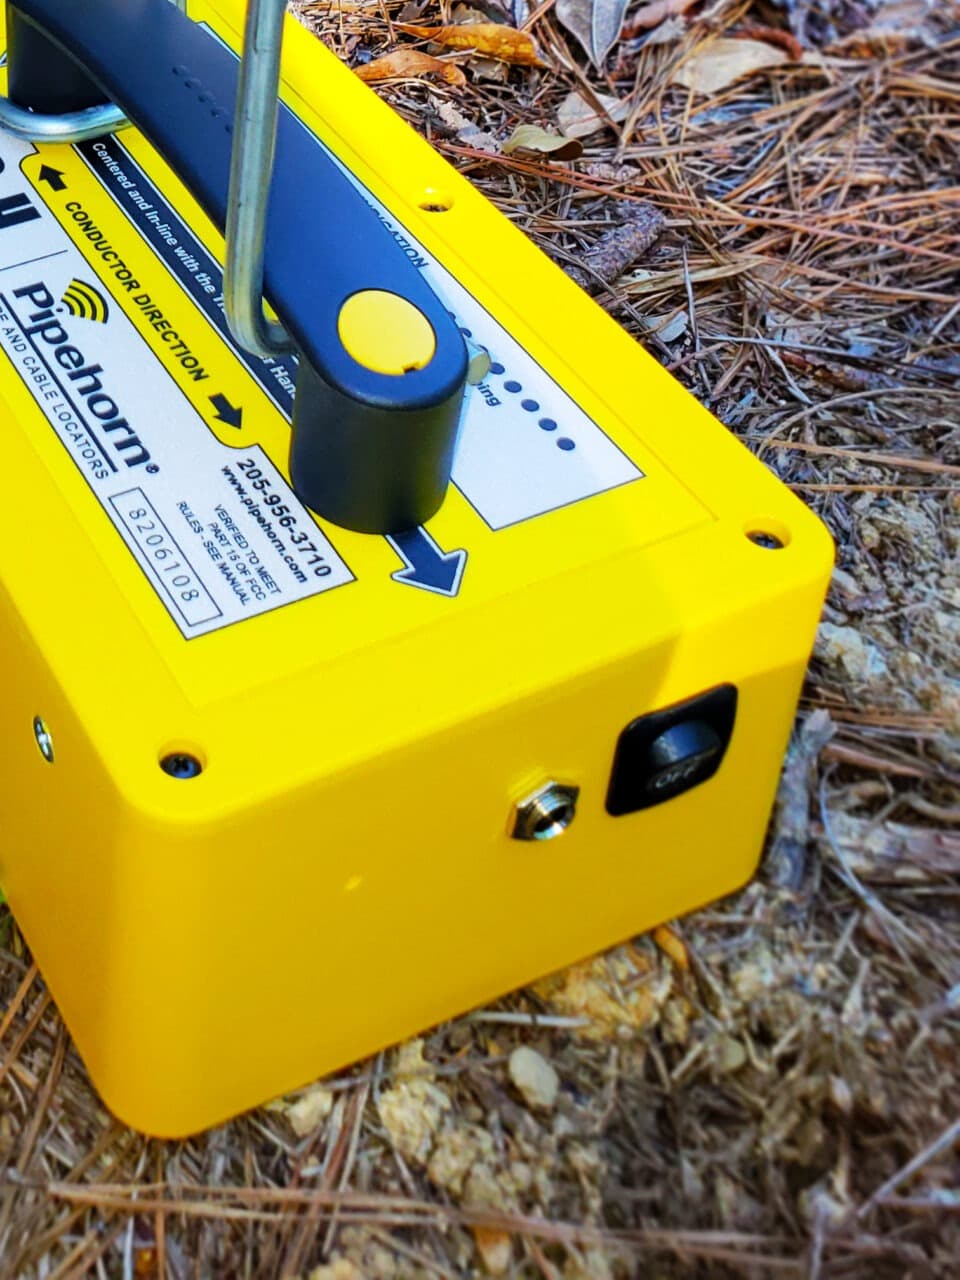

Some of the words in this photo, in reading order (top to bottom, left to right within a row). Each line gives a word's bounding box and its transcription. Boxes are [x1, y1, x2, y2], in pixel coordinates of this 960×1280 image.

[92, 142, 130, 189] Centered
[128, 188, 151, 211] and
[145, 210, 177, 247] In-line
[174, 245, 200, 273] with
[194, 272, 216, 294] the
[65, 201, 140, 292] CONDUCTOR
[133, 293, 209, 381] DIRECTION
[2, 326, 27, 353] AND
[22, 356, 59, 400] CABLE
[53, 403, 109, 480] LOCATORS
[128, 509, 200, 602] 8206108
[176, 501, 204, 534] RULES
[203, 540, 222, 561] SEE
[216, 562, 251, 606] MANUAL
[208, 522, 232, 547] PART
[227, 549, 240, 561] 15
[236, 562, 251, 577] OF
[246, 578, 266, 600] FCC
[214, 504, 249, 549] VERIFIED
[246, 550, 259, 565] TO
[255, 566, 282, 595] MEET
[221, 465, 308, 583] www.pipehorn.com
[236, 458, 332, 577] 205-956-3710
